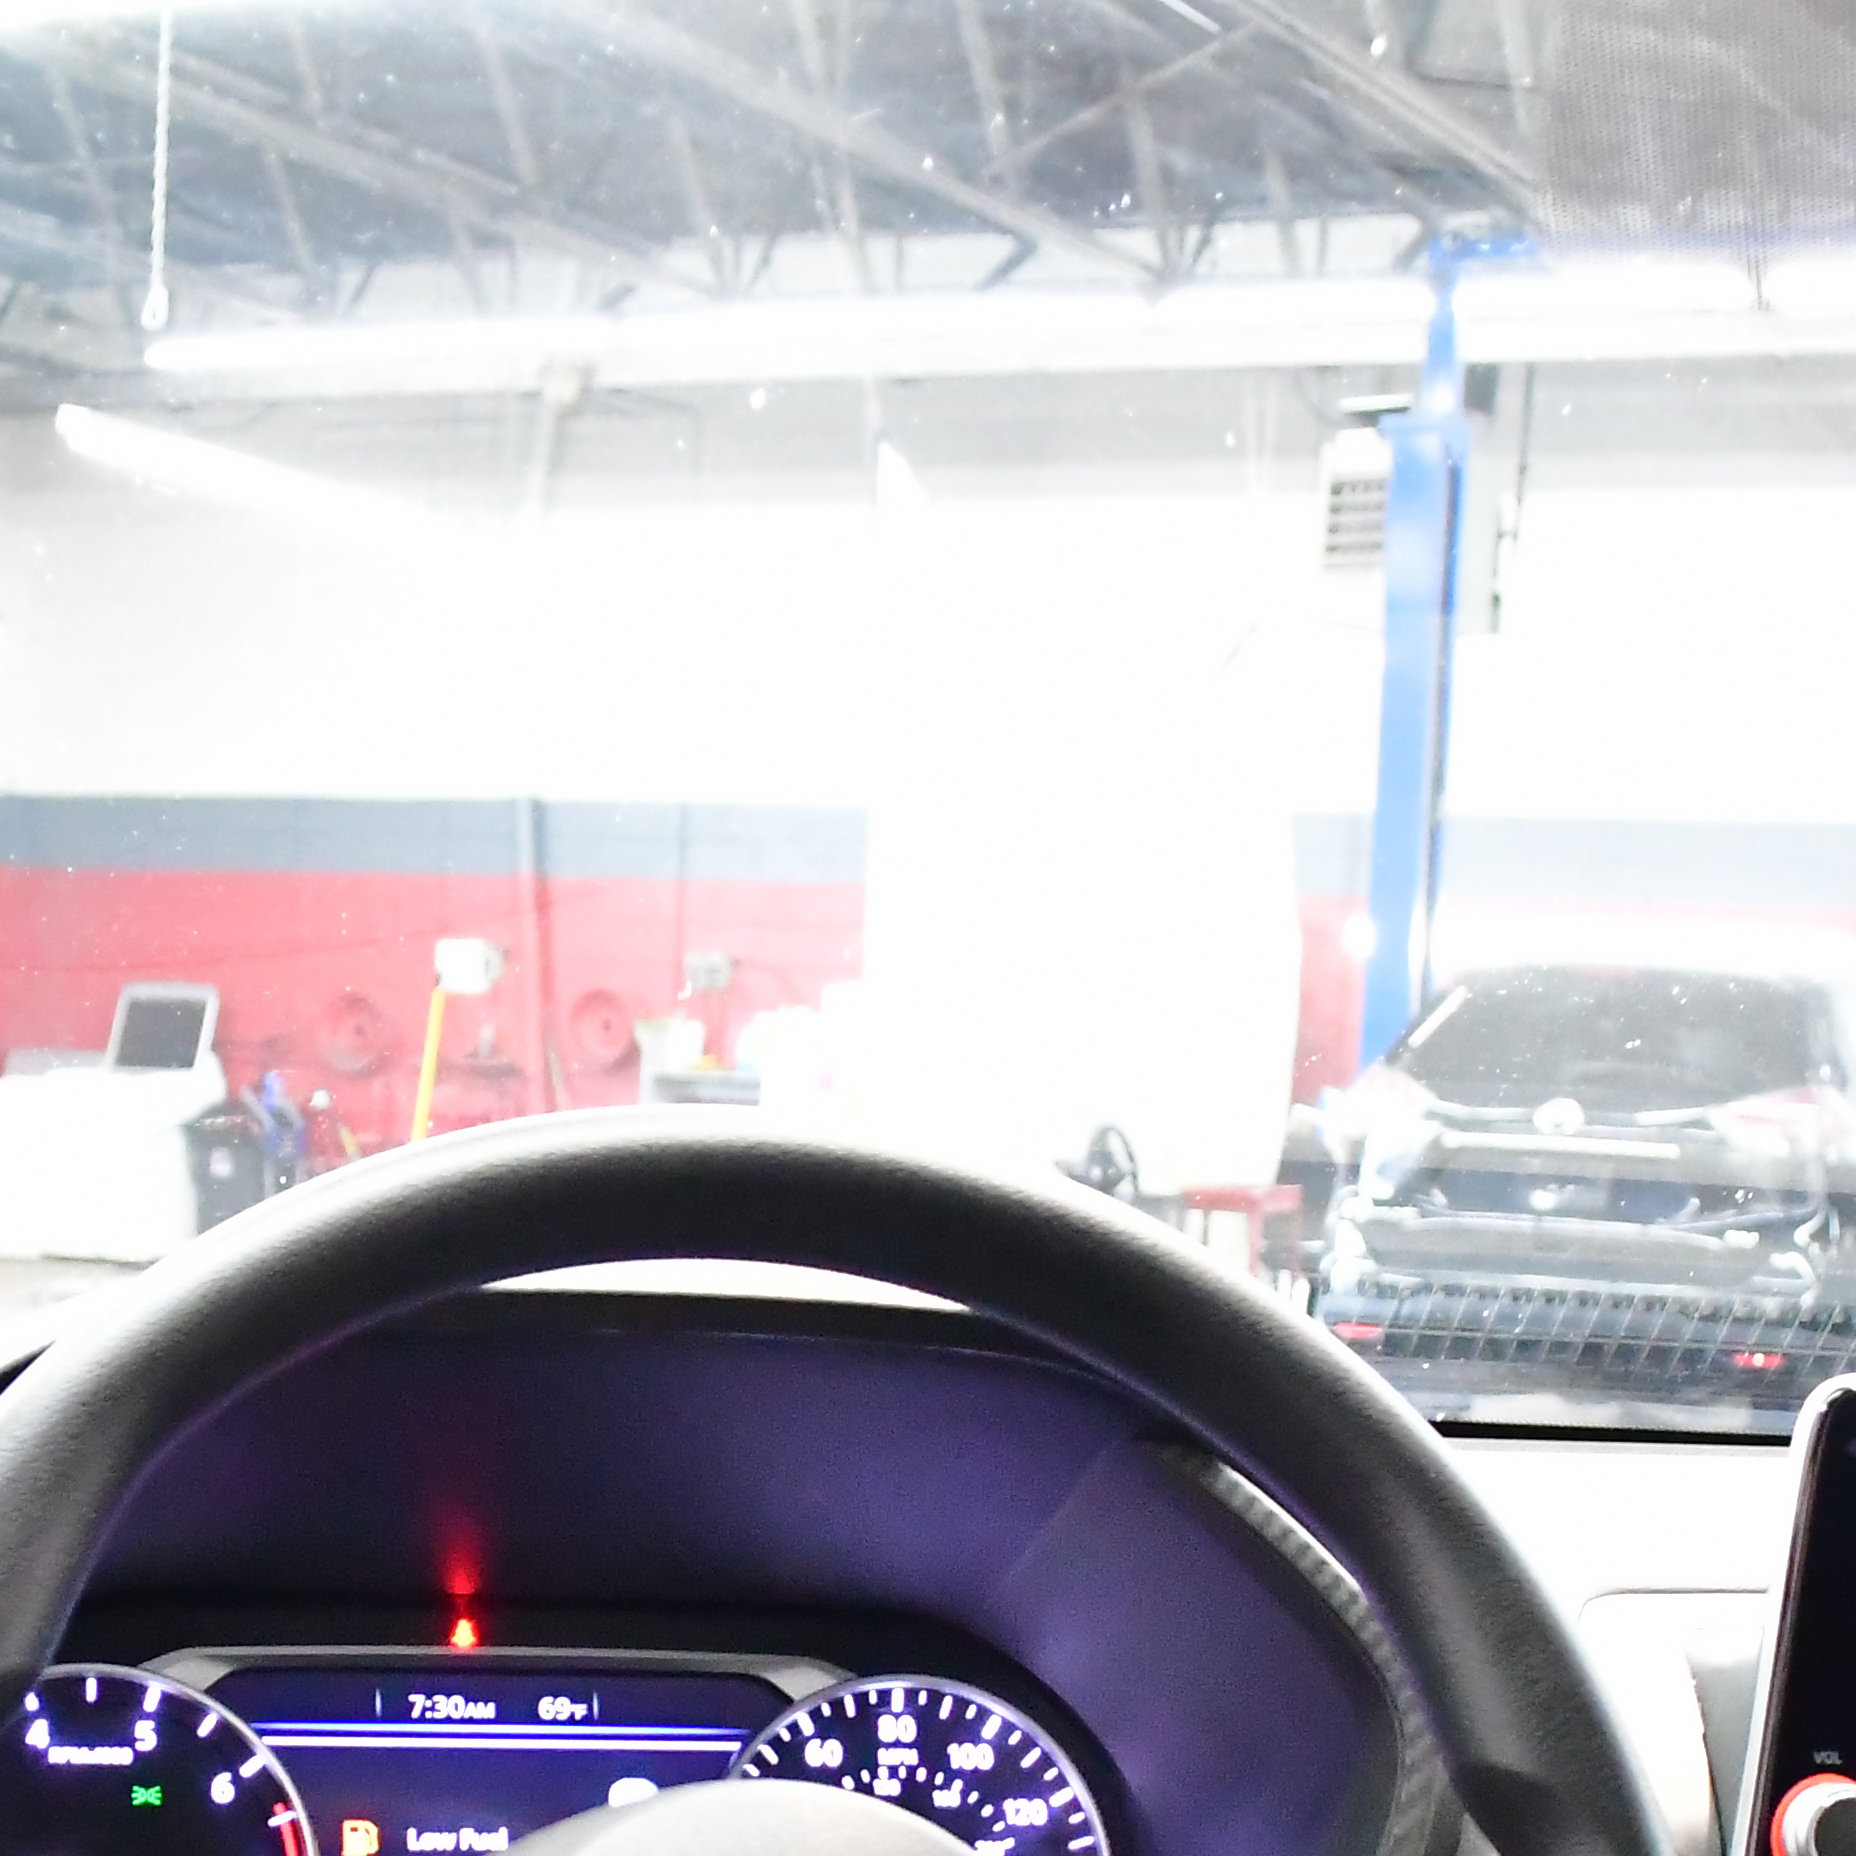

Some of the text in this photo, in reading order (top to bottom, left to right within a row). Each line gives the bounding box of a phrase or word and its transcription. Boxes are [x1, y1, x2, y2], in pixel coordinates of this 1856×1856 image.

[26, 1718, 50, 1749] 4
[134, 1720, 157, 1751] 5
[877, 1714, 917, 1742] 80
[804, 1739, 843, 1768] 60
[947, 1742, 994, 1770] 100
[1813, 1751, 1843, 1765] VOL
[210, 1772, 236, 1804] 6
[1003, 1798, 1048, 1825] 120
